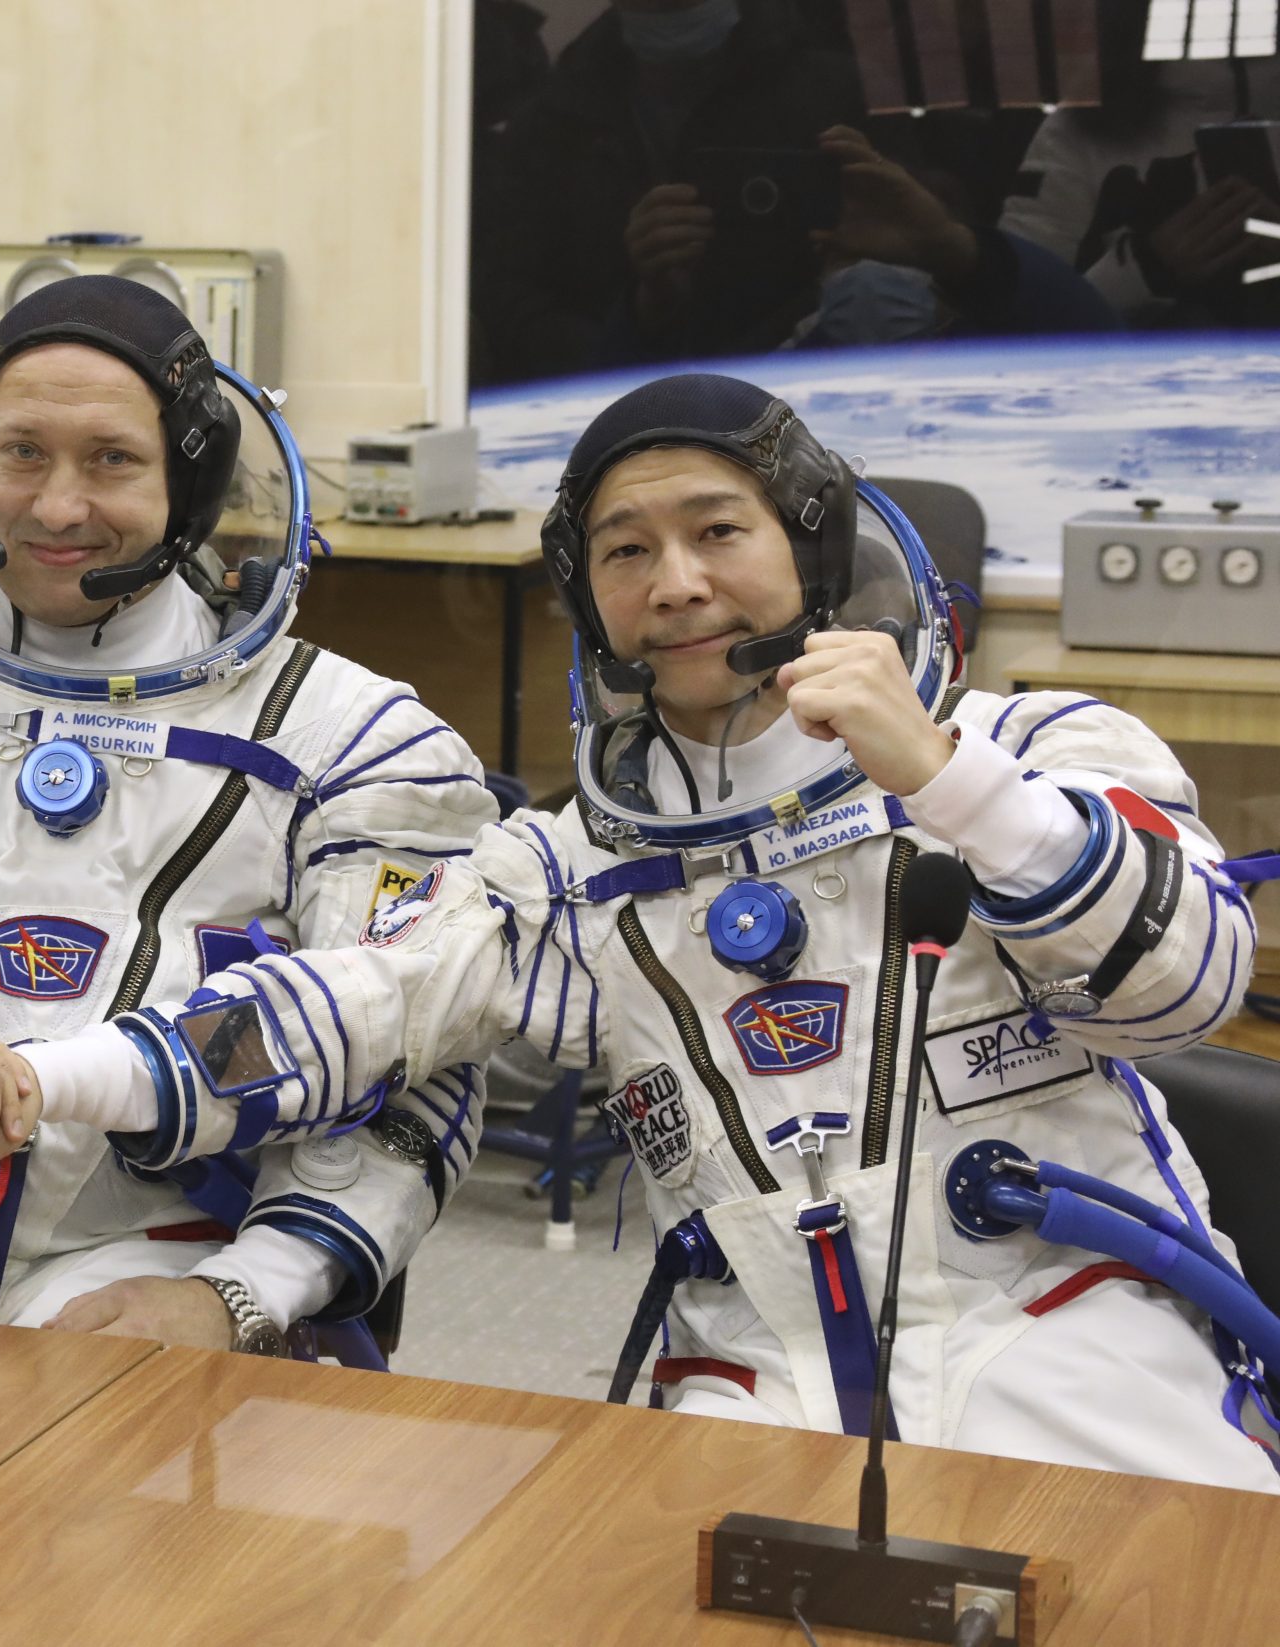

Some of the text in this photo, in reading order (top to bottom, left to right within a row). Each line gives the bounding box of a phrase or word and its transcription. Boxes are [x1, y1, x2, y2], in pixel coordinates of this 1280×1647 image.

[53, 711, 157, 734] А. МИСУРКИН
[763, 802, 869, 845] Y. MAEZAWA
[768, 823, 873, 868] Ю. МАЭЗАВА
[962, 1022, 1052, 1068] SPAC
[984, 1048, 1061, 1076] adventures
[610, 1069, 678, 1124] WORLD
[631, 1100, 686, 1152] PEACE
[645, 1130, 688, 1172] 世界平和
